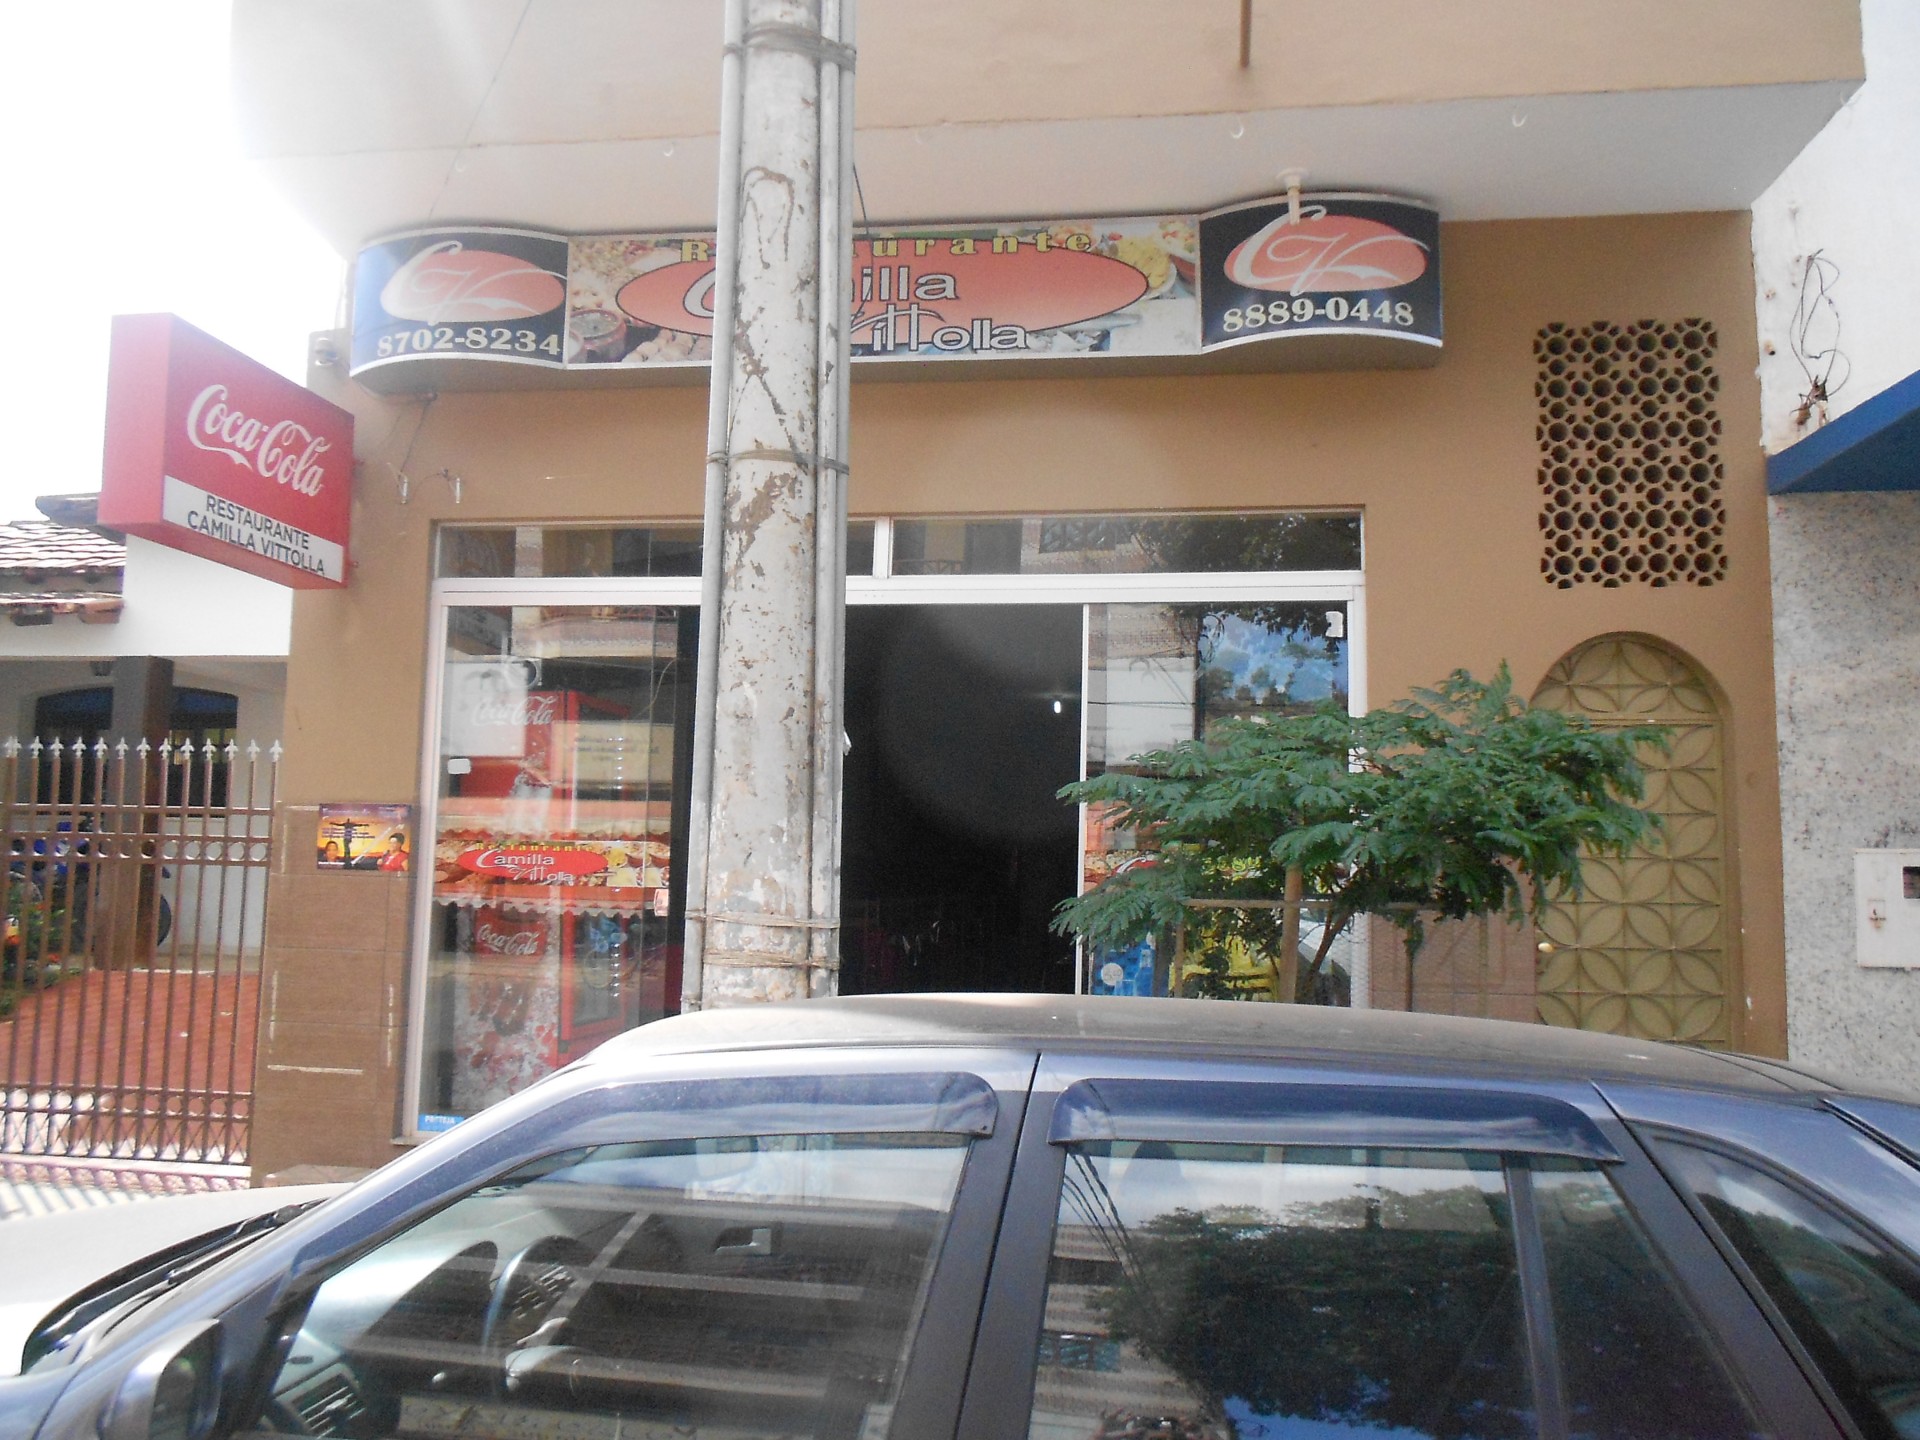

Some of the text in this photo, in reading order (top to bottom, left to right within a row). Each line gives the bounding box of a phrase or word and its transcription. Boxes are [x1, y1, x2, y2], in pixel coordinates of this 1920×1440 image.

[1223, 297, 1414, 332] 8889-0448
[377, 327, 560, 357] 8702-8234
[206, 494, 309, 550] RESTAURANTE
[187, 510, 325, 575] CAMILLA VITTOLLA
[476, 848, 555, 868] Camilla
